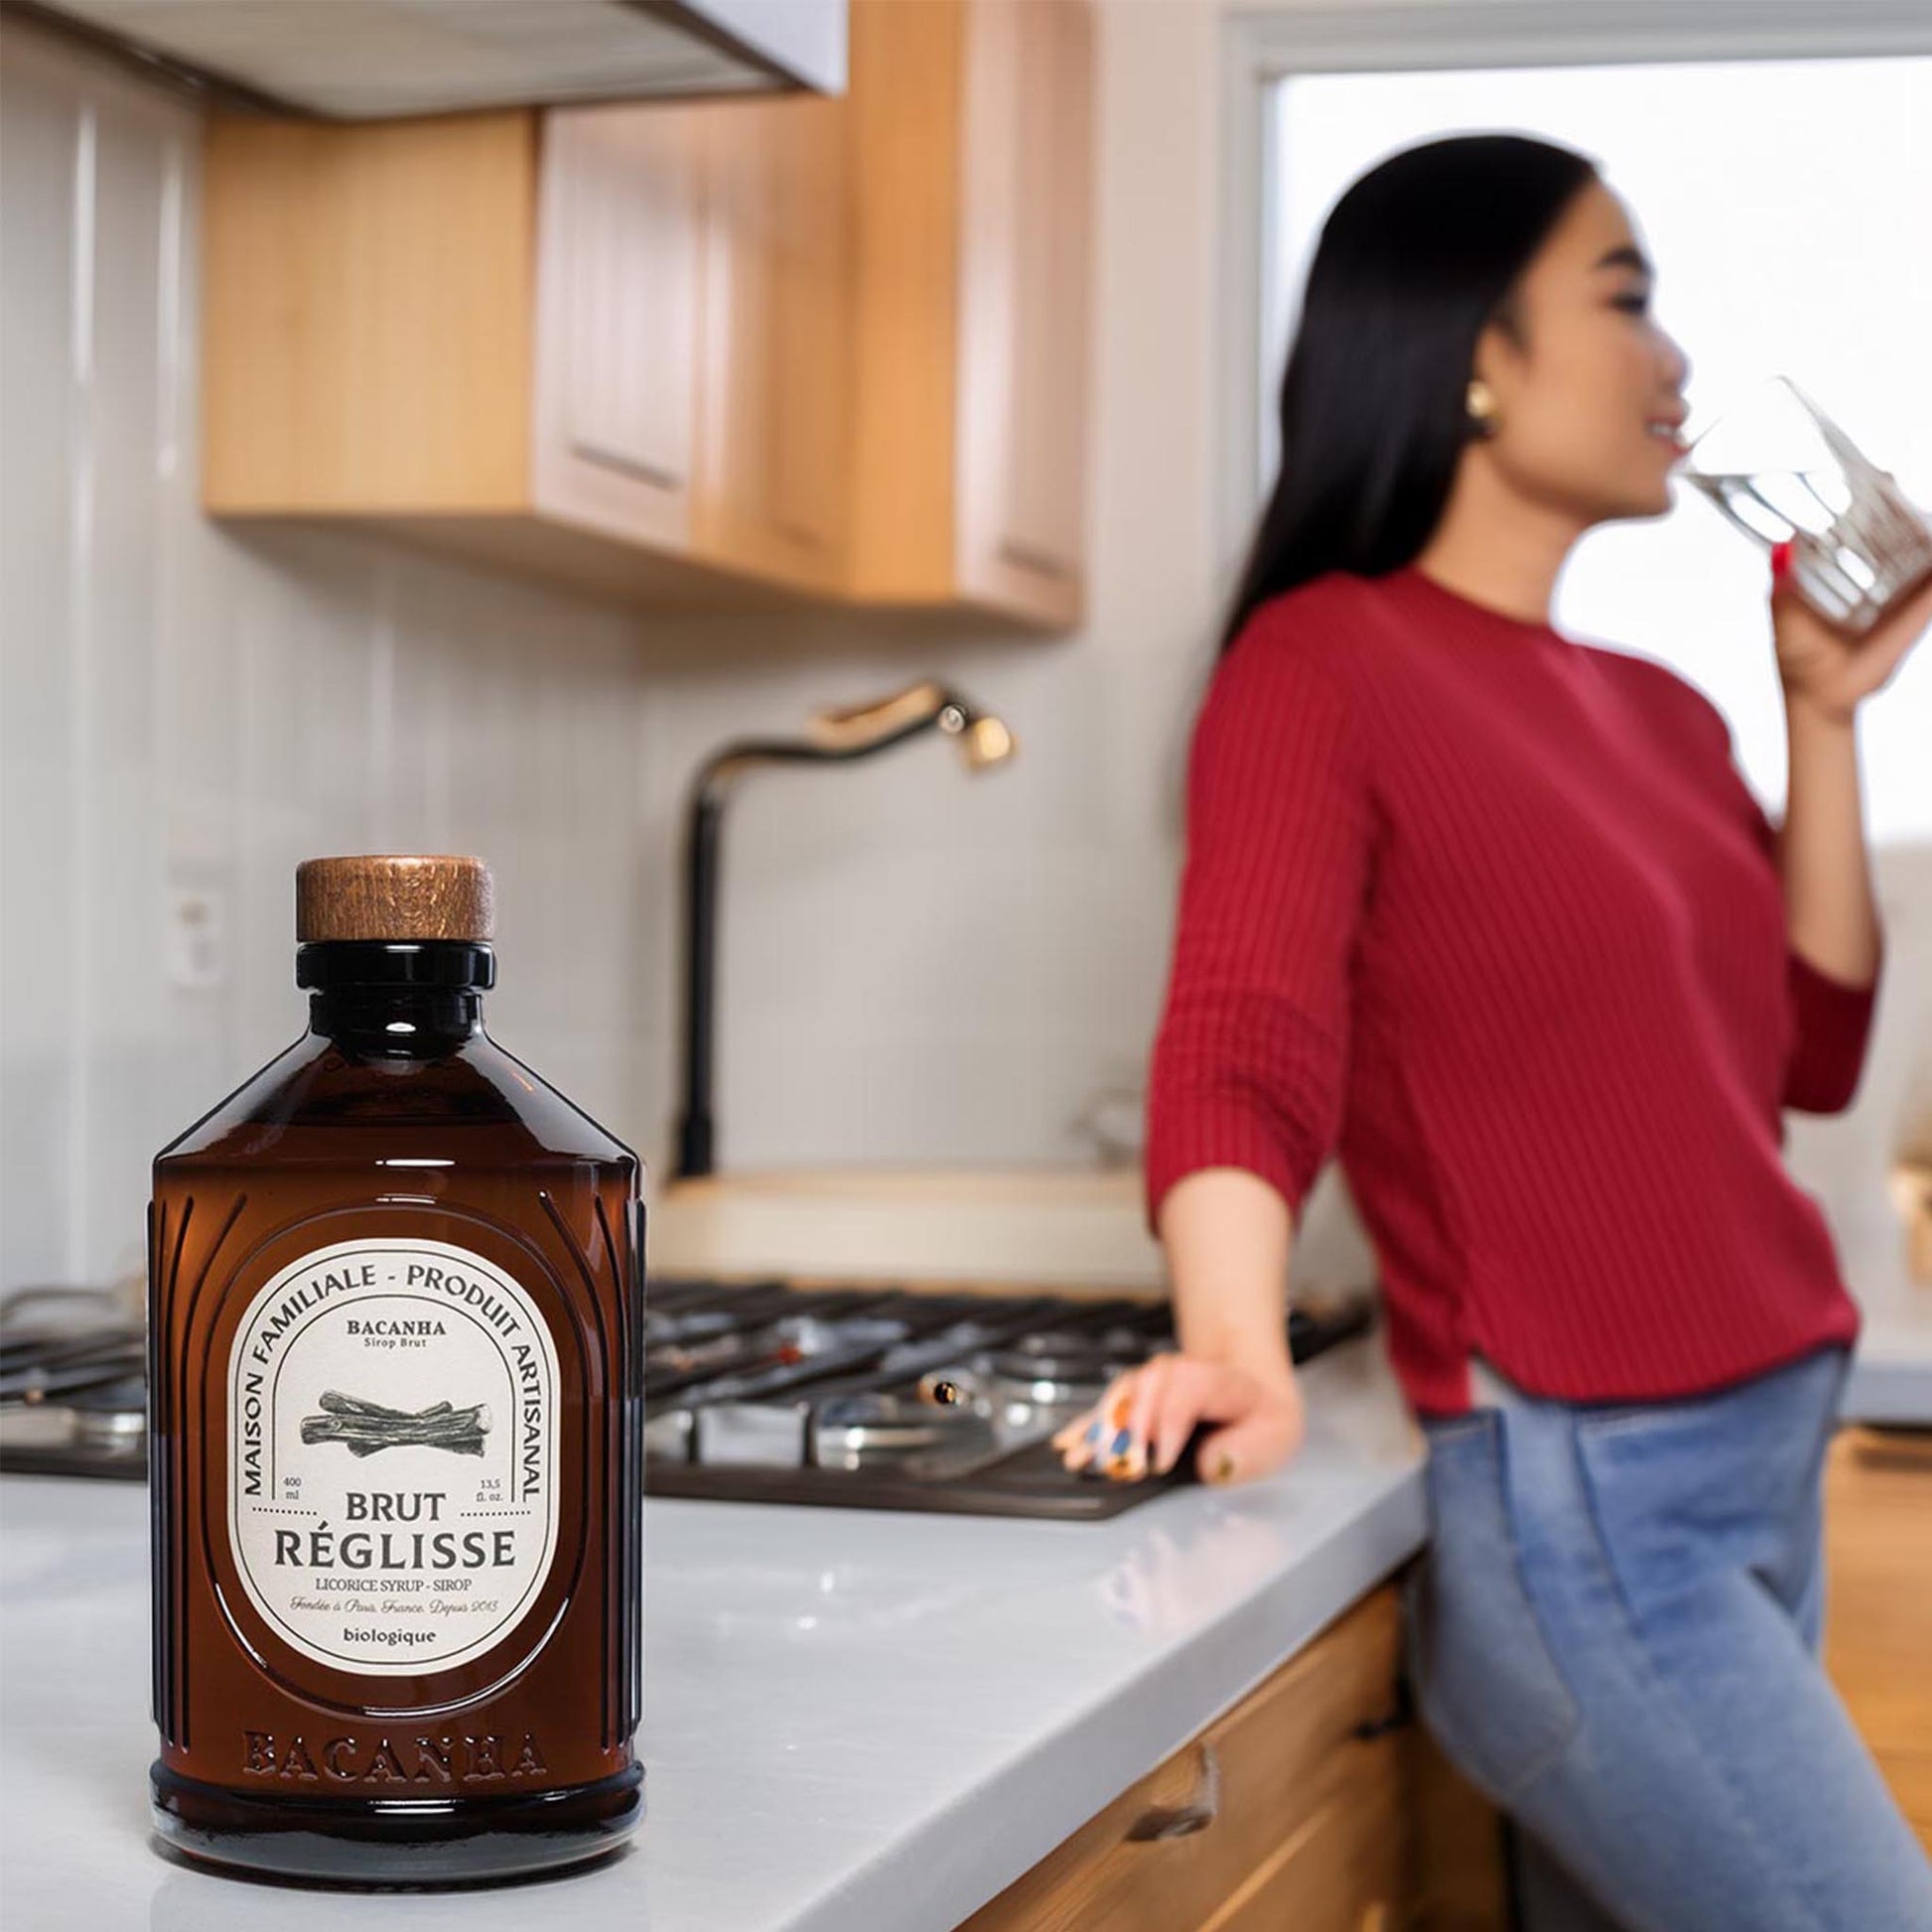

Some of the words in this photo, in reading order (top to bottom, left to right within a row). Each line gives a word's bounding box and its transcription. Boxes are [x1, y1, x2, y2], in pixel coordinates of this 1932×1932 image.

[406, 1264, 521, 1337] PRODUIT
[252, 1264, 376, 1365] FAMILIALE
[346, 1319, 447, 1335] BACANHA
[363, 1337, 396, 1350] Sirop
[399, 1338, 427, 1348] Brut
[245, 1372, 264, 1496] MAISON
[510, 1343, 541, 1503] ARTISANAL
[283, 1477, 303, 1487] 400
[285, 1490, 300, 1500] ml
[345, 1492, 447, 1522] BRUT
[274, 1520, 516, 1570] RÉGLISSE
[315, 1578, 378, 1591] LICORICE
[379, 1580, 425, 1592] SYRUP
[432, 1579, 473, 1591] SIROP
[429, 1598, 468, 1617] Depuis
[344, 1627, 437, 1646] biologique
[243, 1730, 547, 1783] BACANHA
